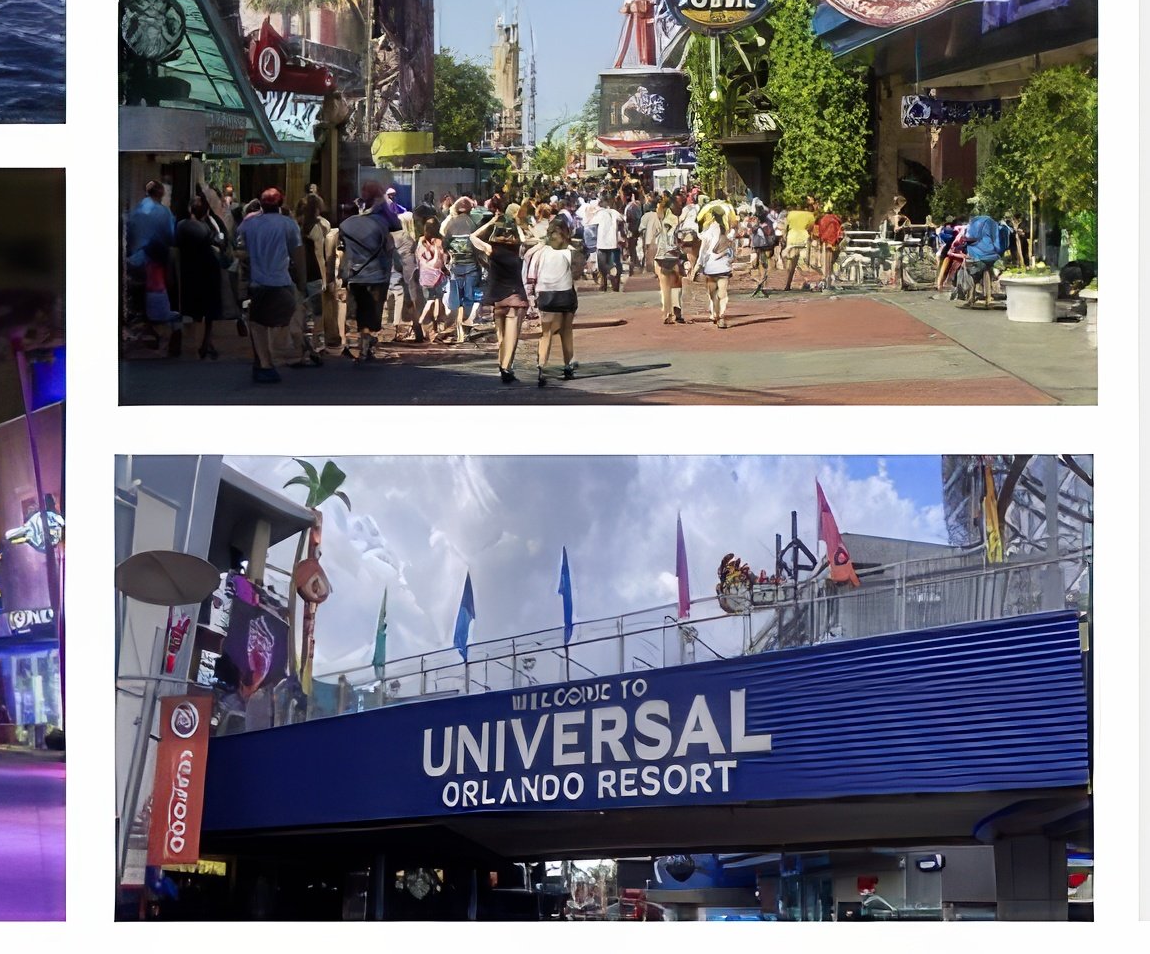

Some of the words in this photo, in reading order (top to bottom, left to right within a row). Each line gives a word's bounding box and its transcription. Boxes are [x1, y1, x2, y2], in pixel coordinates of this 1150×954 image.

[620, 677, 648, 700] TO
[422, 688, 772, 777] UNIVERSAL
[442, 771, 584, 807] ORLANDO
[597, 759, 737, 799] RESORT
